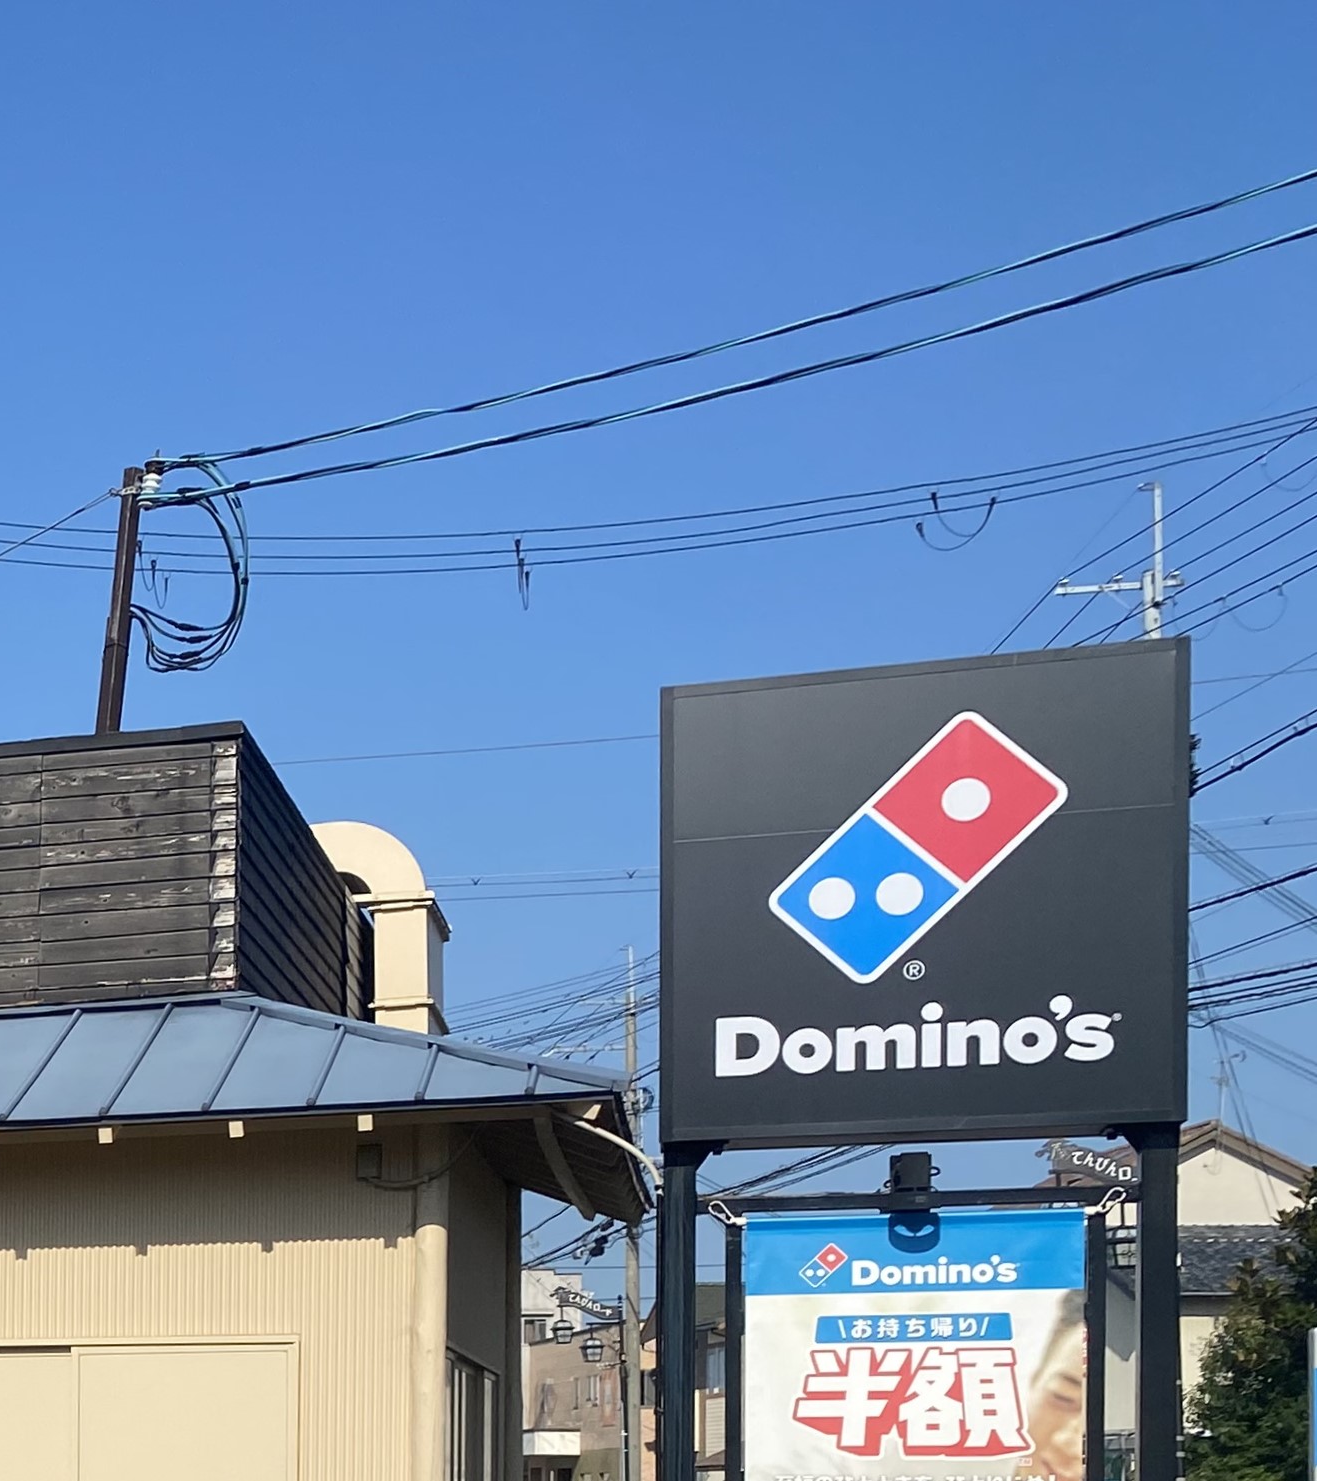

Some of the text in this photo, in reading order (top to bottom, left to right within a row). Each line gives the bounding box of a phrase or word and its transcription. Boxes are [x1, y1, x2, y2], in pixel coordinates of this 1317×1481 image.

[715, 995, 1115, 1077] Domino's
[851, 1255, 1018, 1286] Domino's
[793, 1347, 1031, 1456] 半額
